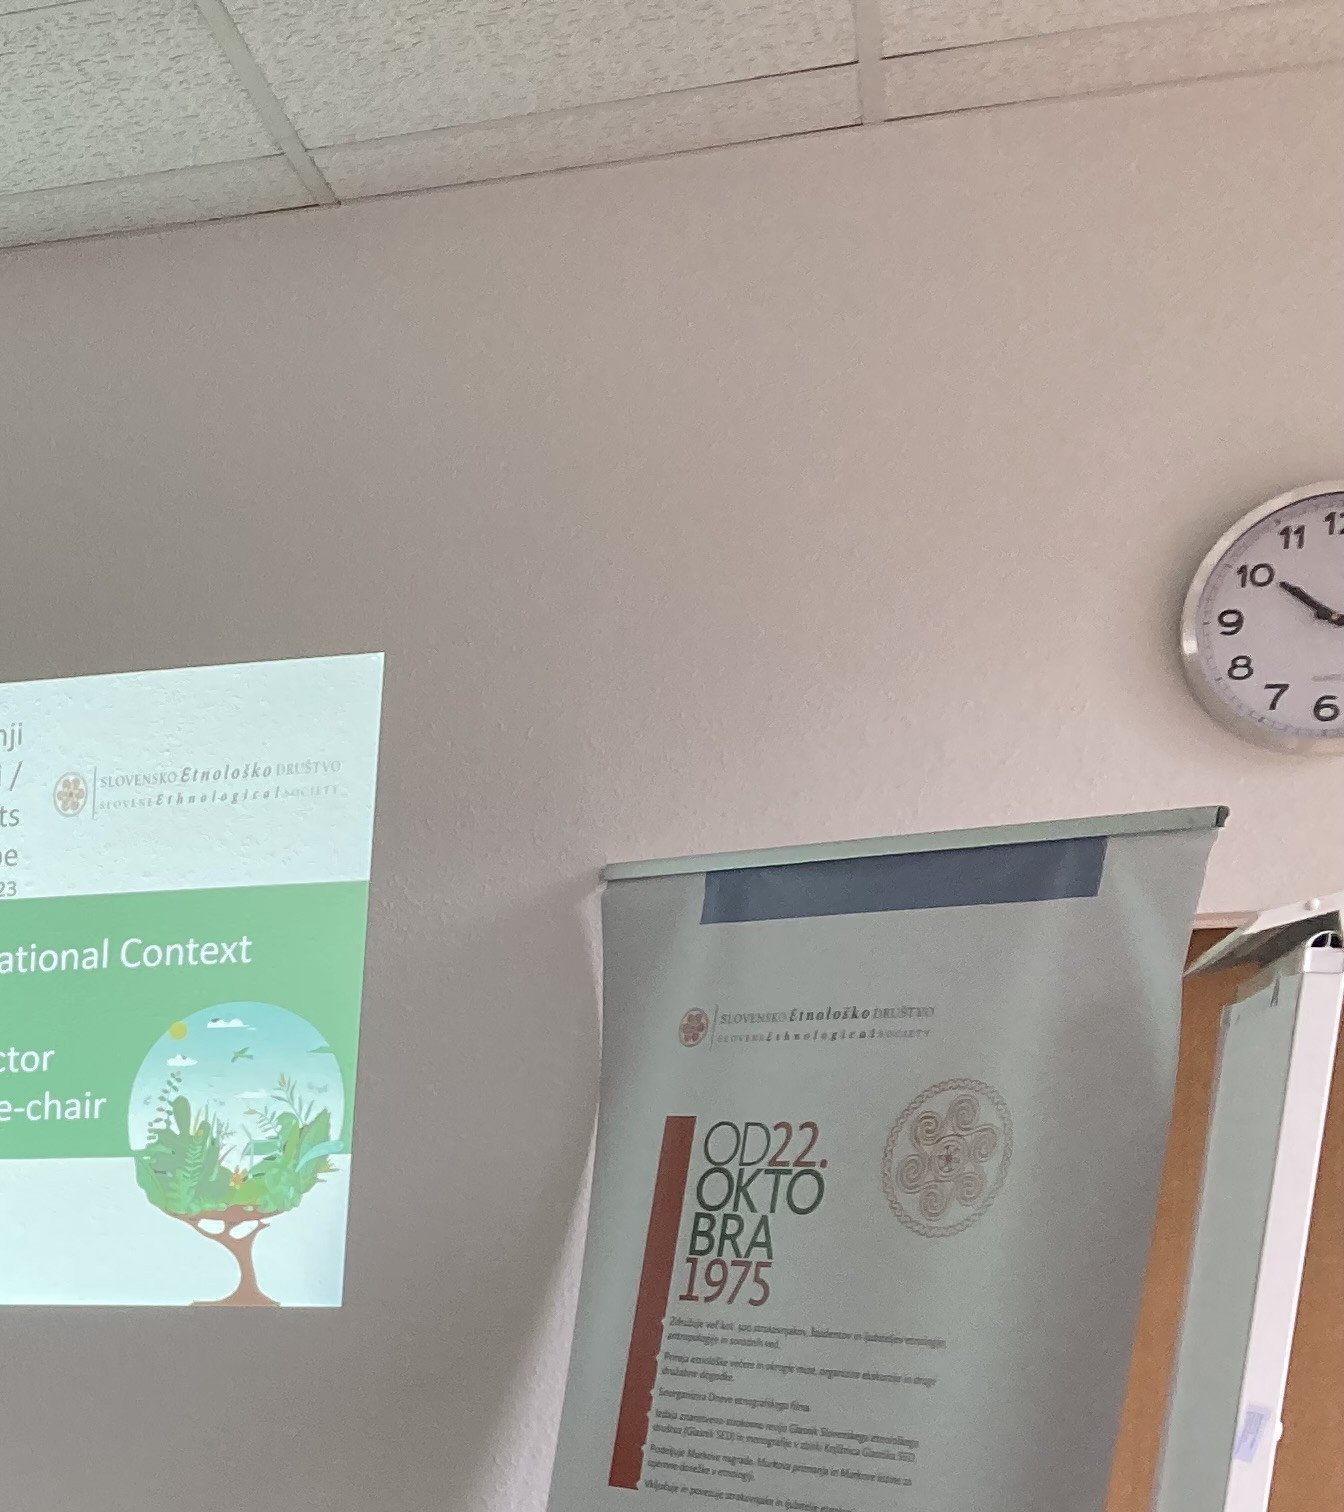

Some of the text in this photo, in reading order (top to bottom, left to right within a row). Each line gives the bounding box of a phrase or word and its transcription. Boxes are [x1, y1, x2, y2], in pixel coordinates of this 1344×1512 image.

[1324, 511, 1344, 535] 1
[1279, 525, 1306, 549] 11
[1237, 563, 1275, 588] 10
[1217, 609, 1245, 635] 9
[1227, 655, 1254, 680] 8
[1264, 683, 1290, 710] 7
[1313, 694, 1340, 722] 6
[9, 760, 25, 793] /
[180, 761, 272, 783] Etnološko
[120, 935, 253, 969] Context
[696, 1166, 825, 1215] OKTO
[688, 1211, 774, 1260] BRA
[678, 1256, 773, 1307] 1975
